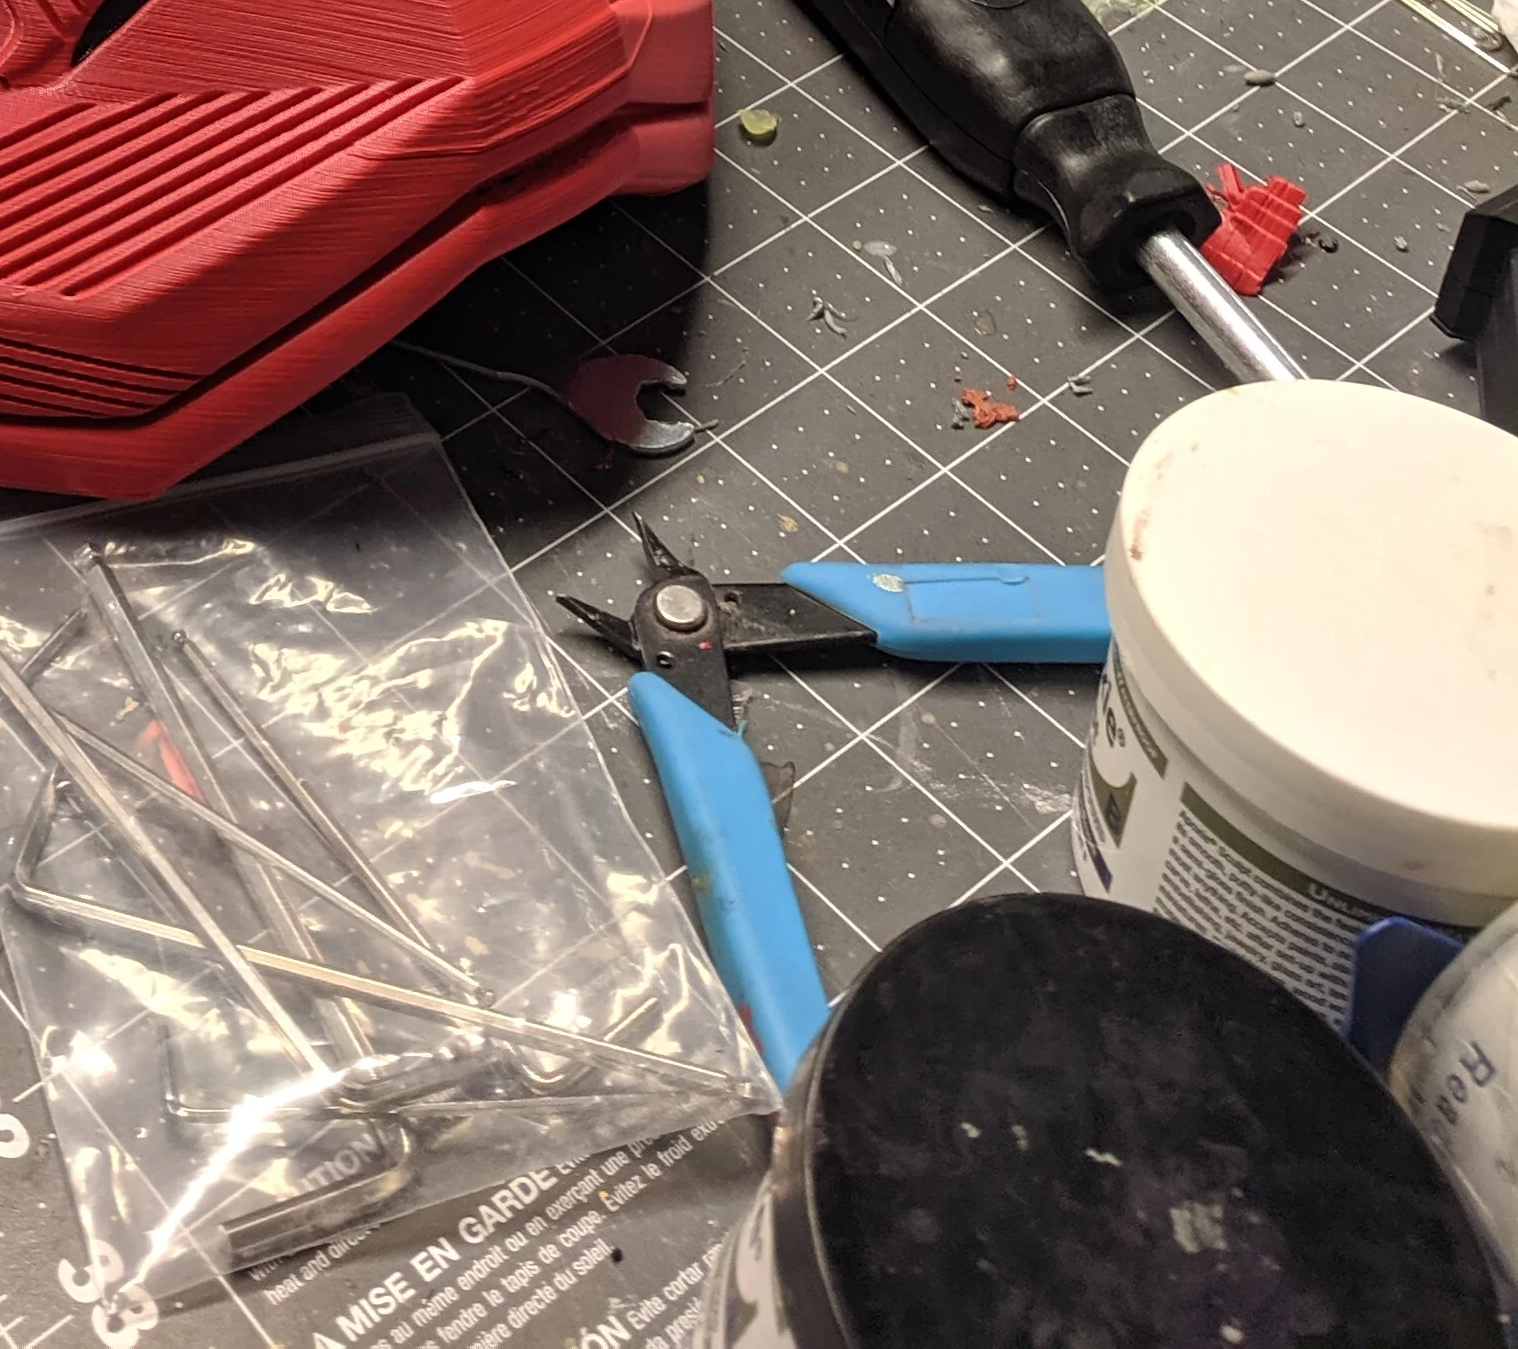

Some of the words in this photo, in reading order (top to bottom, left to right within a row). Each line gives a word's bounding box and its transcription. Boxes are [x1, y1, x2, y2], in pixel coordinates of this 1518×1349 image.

[58, 1239, 159, 1349] 33
[262, 1274, 305, 1306] heat
[300, 1251, 331, 1283] and
[336, 1272, 415, 1341] MISE
[410, 1238, 460, 1282] EN
[459, 1165, 556, 1243] GARDE
[390, 1321, 414, 1344] au
[457, 1245, 508, 1290] endroit
[504, 1231, 528, 1252] ou
[525, 1216, 548, 1236] en
[546, 1169, 604, 1220] exerçant
[600, 1151, 630, 1176] une
[436, 1303, 487, 1343] fendre
[482, 1289, 505, 1307] le
[500, 1260, 540, 1293] tapis
[538, 1244, 561, 1264] de
[557, 1211, 606, 1248] coupe.
[641, 1163, 662, 1179] le
[657, 1135, 693, 1167] froid
[553, 1269, 577, 1291] du
[572, 1238, 613, 1275] soleil.
[663, 1262, 704, 1301] cortar
